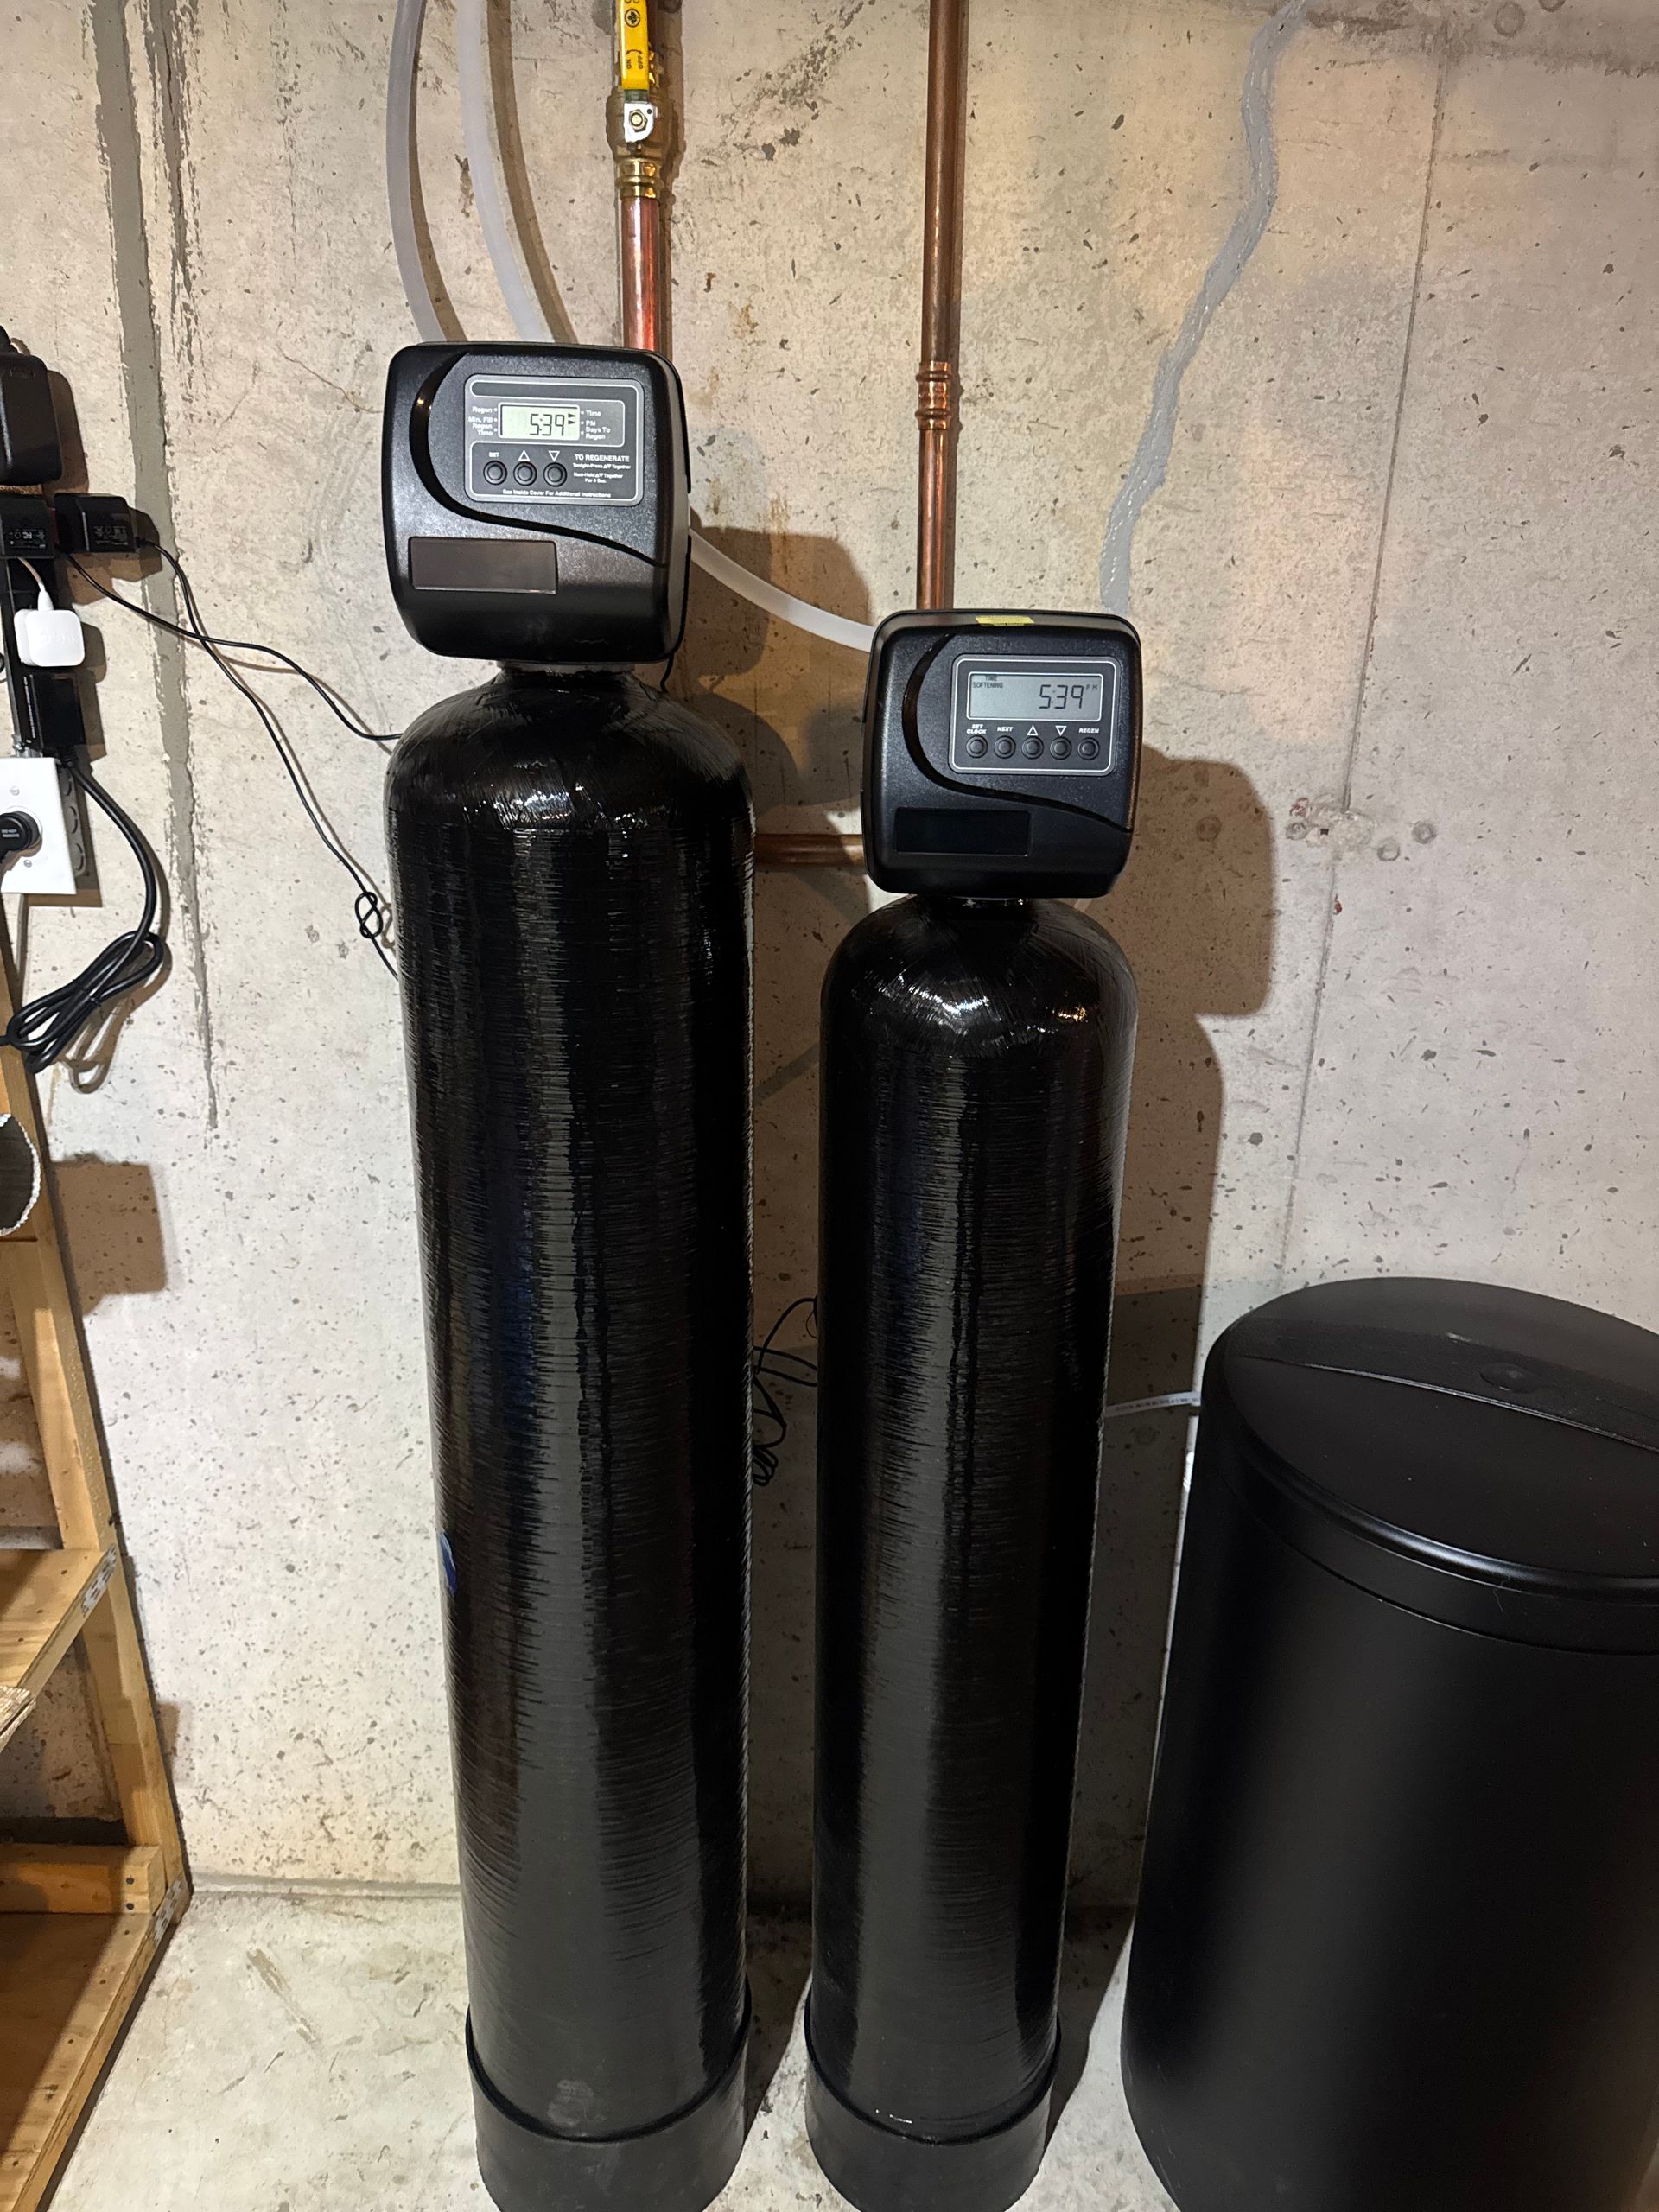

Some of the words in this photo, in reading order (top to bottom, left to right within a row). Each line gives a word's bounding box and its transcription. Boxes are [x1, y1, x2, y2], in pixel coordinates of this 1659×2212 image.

[472, 405, 493, 414] Regen
[530, 413, 564, 436] 5:39
[585, 454, 630, 462] REGENERATE
[1038, 684, 1084, 709] 5:39
